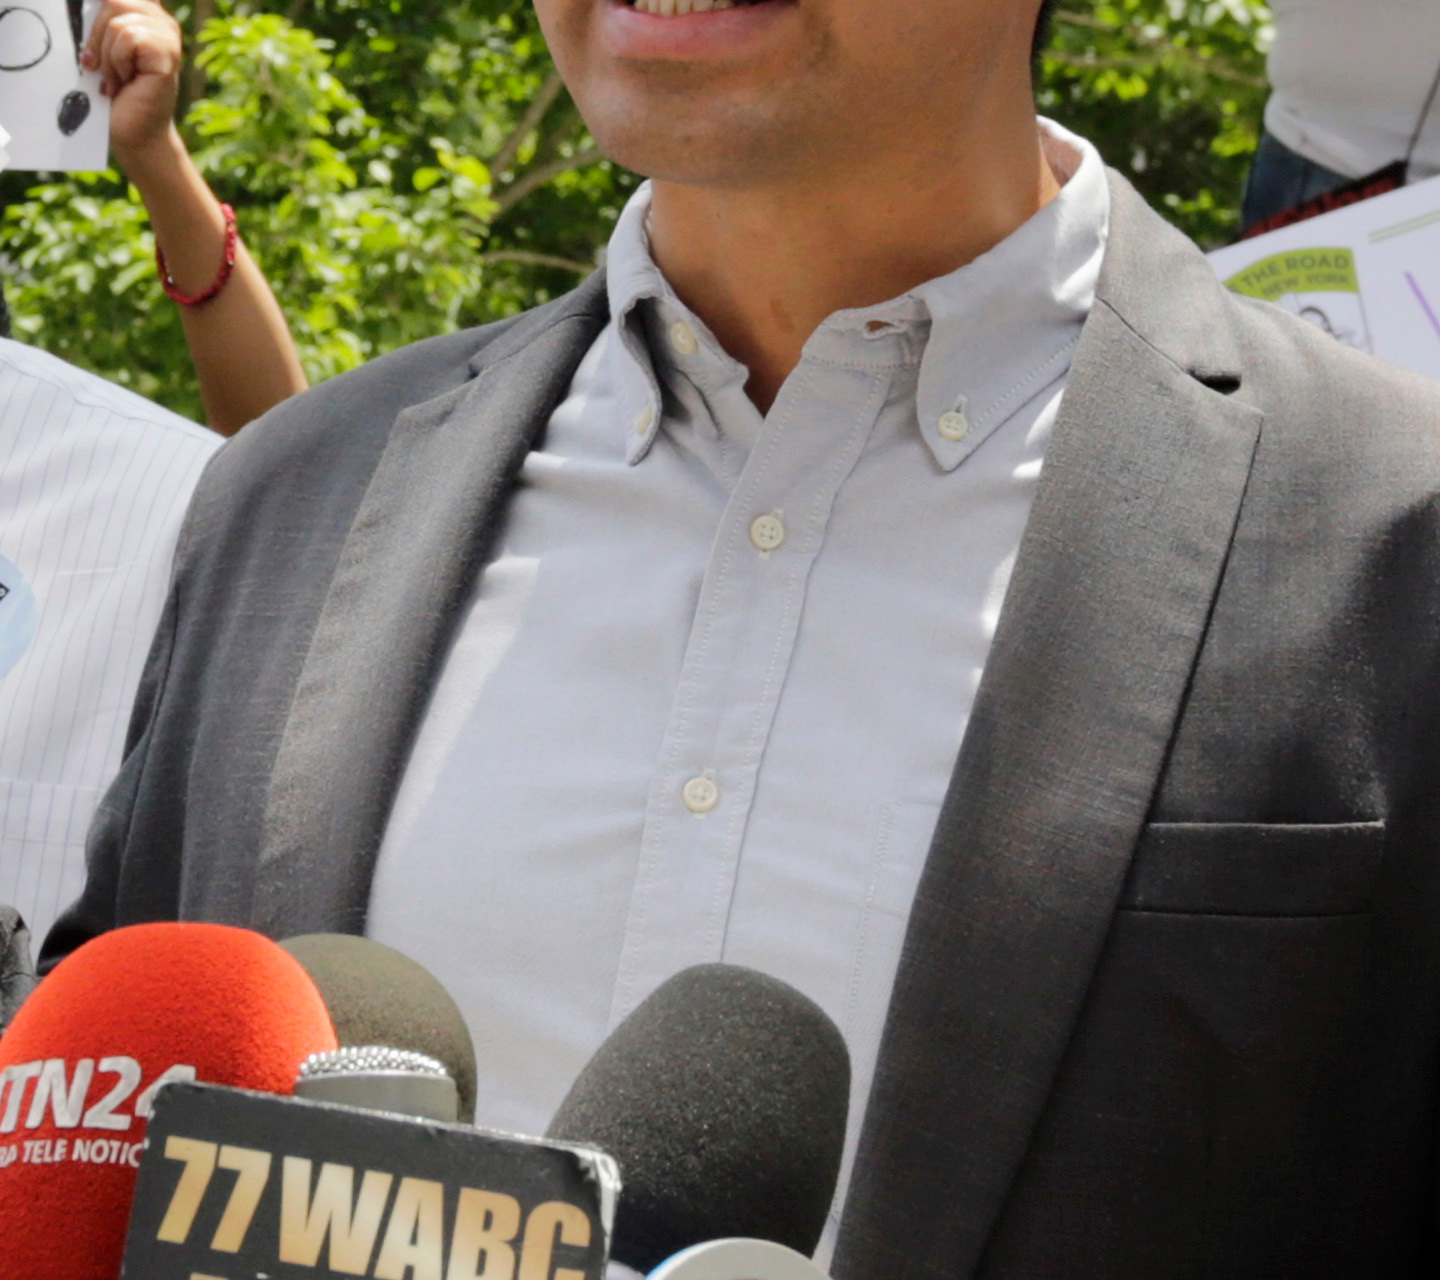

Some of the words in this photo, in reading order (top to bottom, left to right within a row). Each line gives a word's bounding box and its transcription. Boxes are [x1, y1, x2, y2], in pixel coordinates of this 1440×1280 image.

[1285, 254, 1350, 271] ROAD
[22, 1138, 69, 1164] TELE
[71, 1138, 150, 1169] NOTIC
